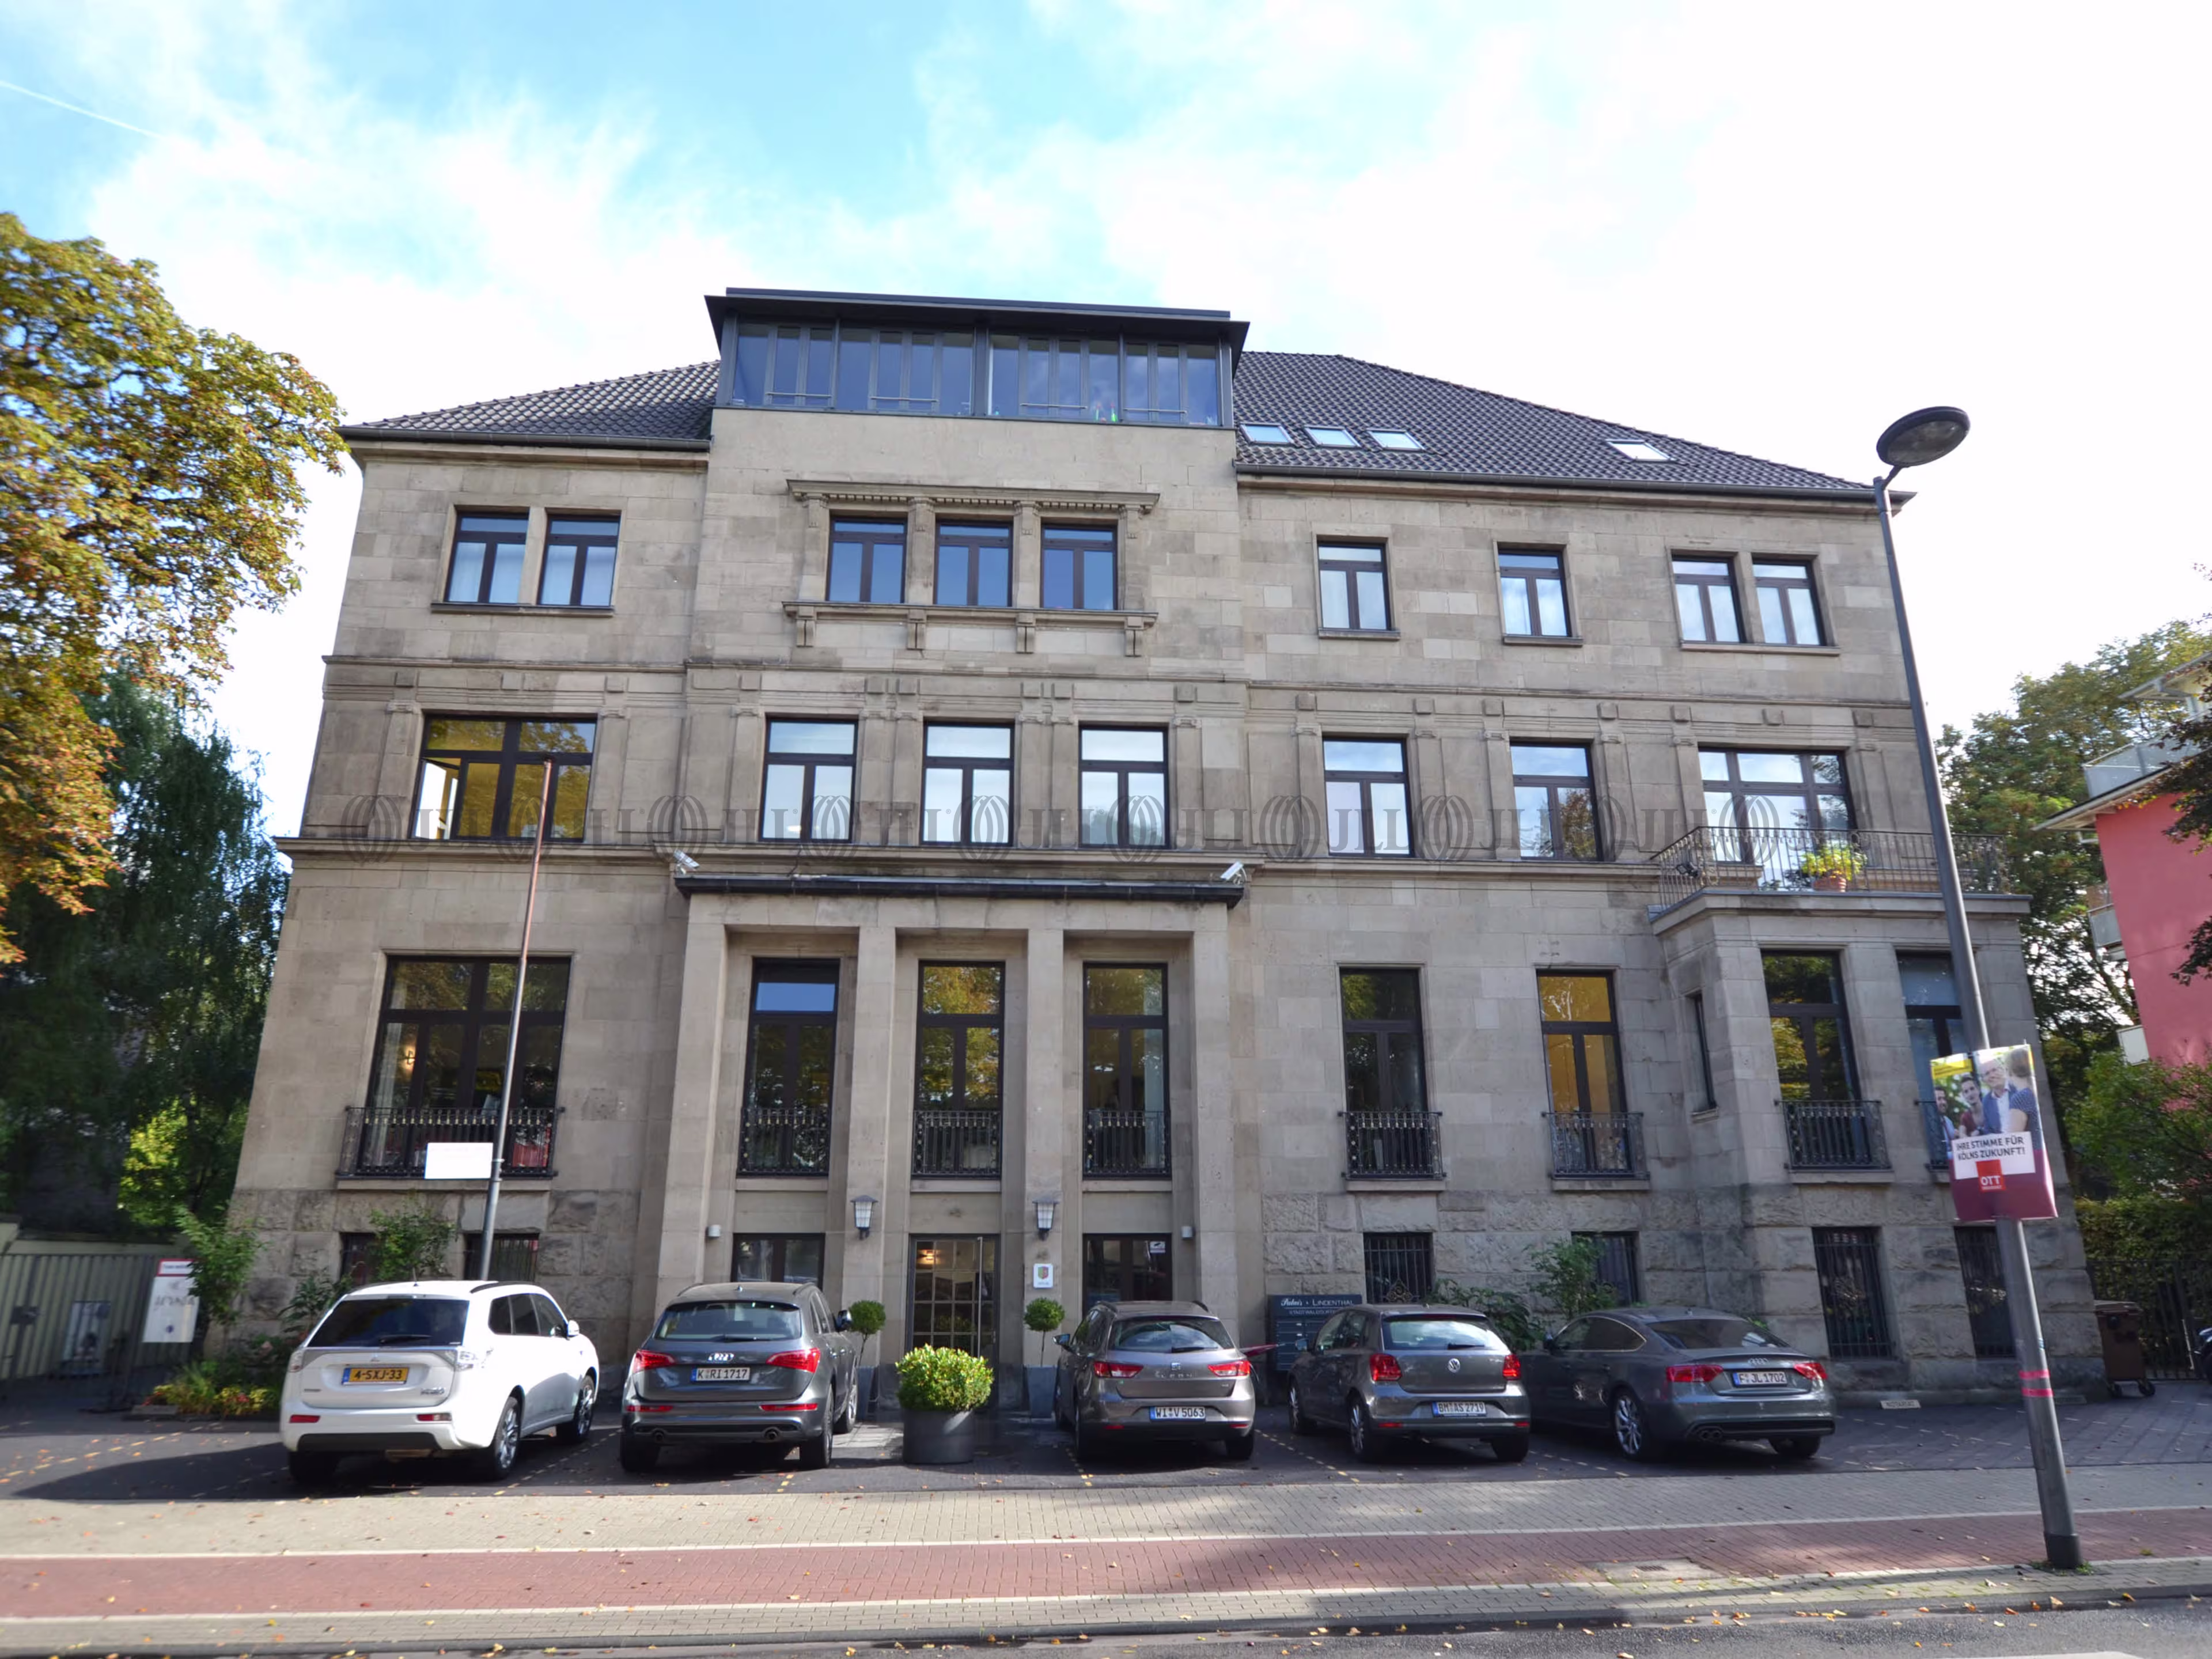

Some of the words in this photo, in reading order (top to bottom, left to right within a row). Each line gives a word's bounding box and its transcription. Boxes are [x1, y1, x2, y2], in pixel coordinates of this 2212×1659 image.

[1956, 1142, 1970, 1152] IHRE
[1971, 1138, 2003, 1149] STIMME
[2005, 1135, 2024, 1145] FÜR
[1958, 1151, 1979, 1160] KÖLNS
[1980, 1147, 2025, 1158] ZUKUNFT!
[1982, 1176, 2001, 1185] OTT
[355, 1369, 402, 1380] 4-SXJ-33
